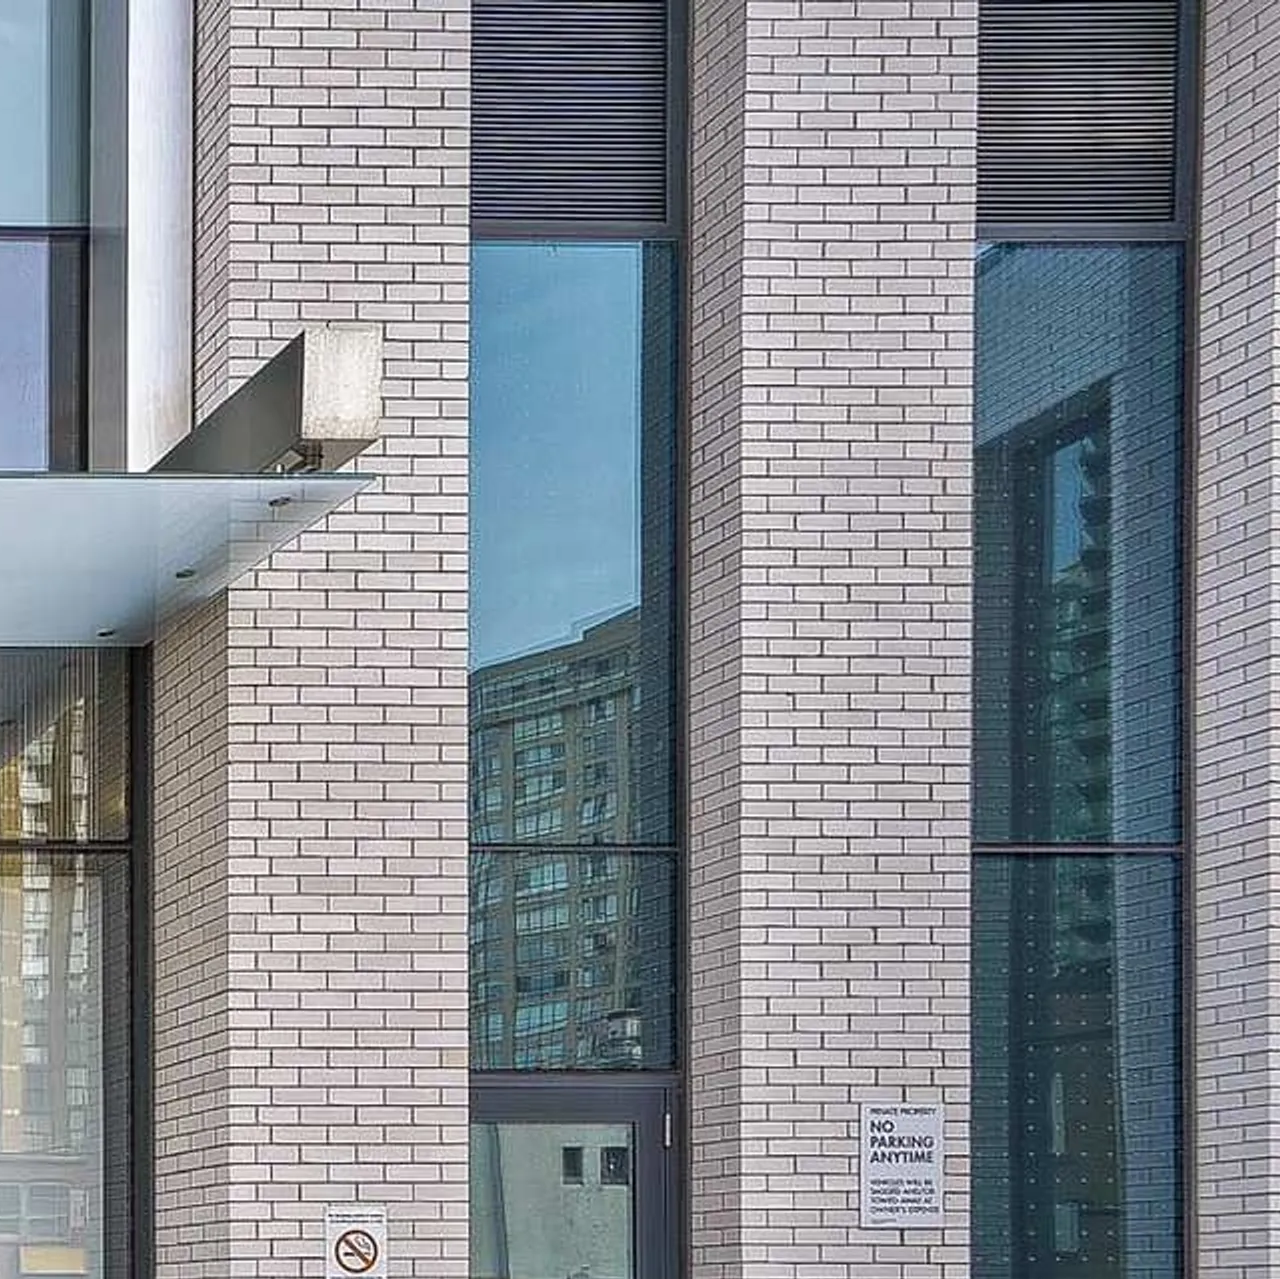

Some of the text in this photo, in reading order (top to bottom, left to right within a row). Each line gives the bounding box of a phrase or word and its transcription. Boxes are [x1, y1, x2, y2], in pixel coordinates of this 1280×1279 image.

[870, 1120, 895, 1133] NO
[870, 1136, 934, 1148] PARKING
[870, 1151, 933, 1163] ANYTIME
